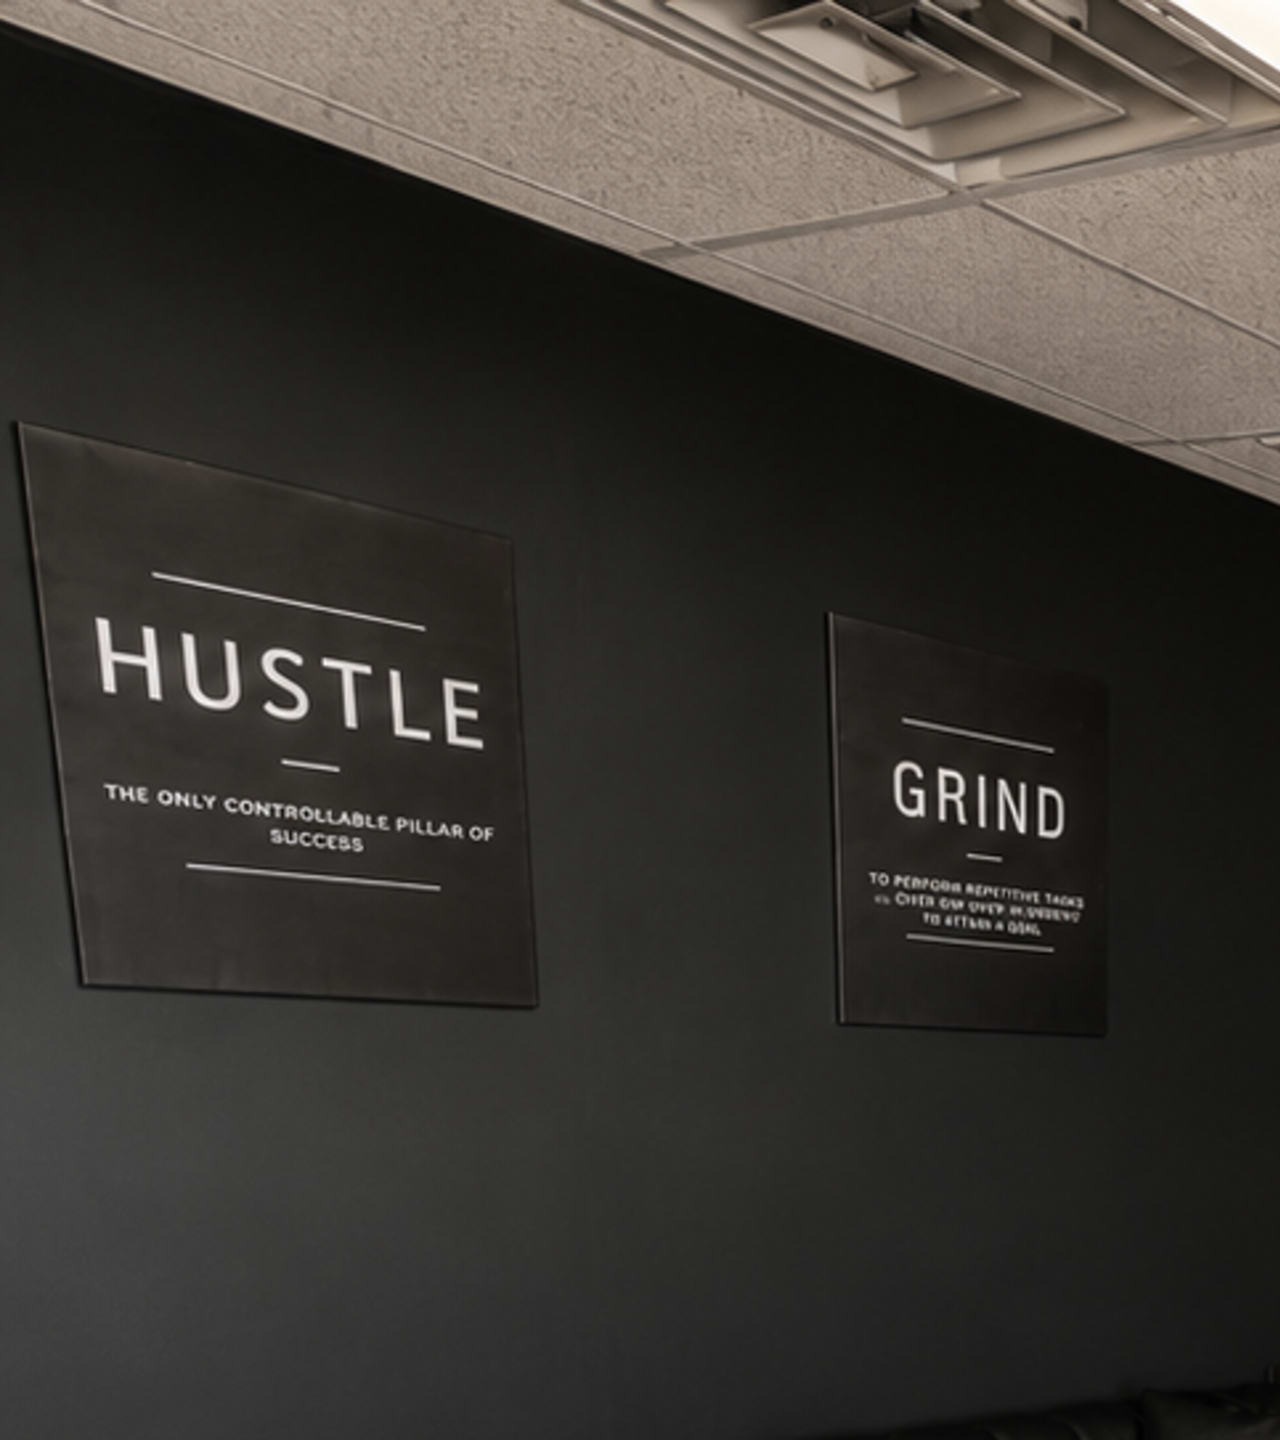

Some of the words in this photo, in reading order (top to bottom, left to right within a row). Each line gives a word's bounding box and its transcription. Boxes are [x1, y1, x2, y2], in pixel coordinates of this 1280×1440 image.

[95, 616, 485, 750] HUSTLE
[103, 783, 149, 805] THE
[157, 789, 216, 811] ONLY
[223, 797, 390, 832] CONTROLLABLE
[396, 816, 464, 840] PILLAR
[469, 825, 494, 843] OF
[892, 760, 1066, 840] GRIND
[270, 827, 364, 853] SUCCESS
[869, 871, 890, 887] TO
